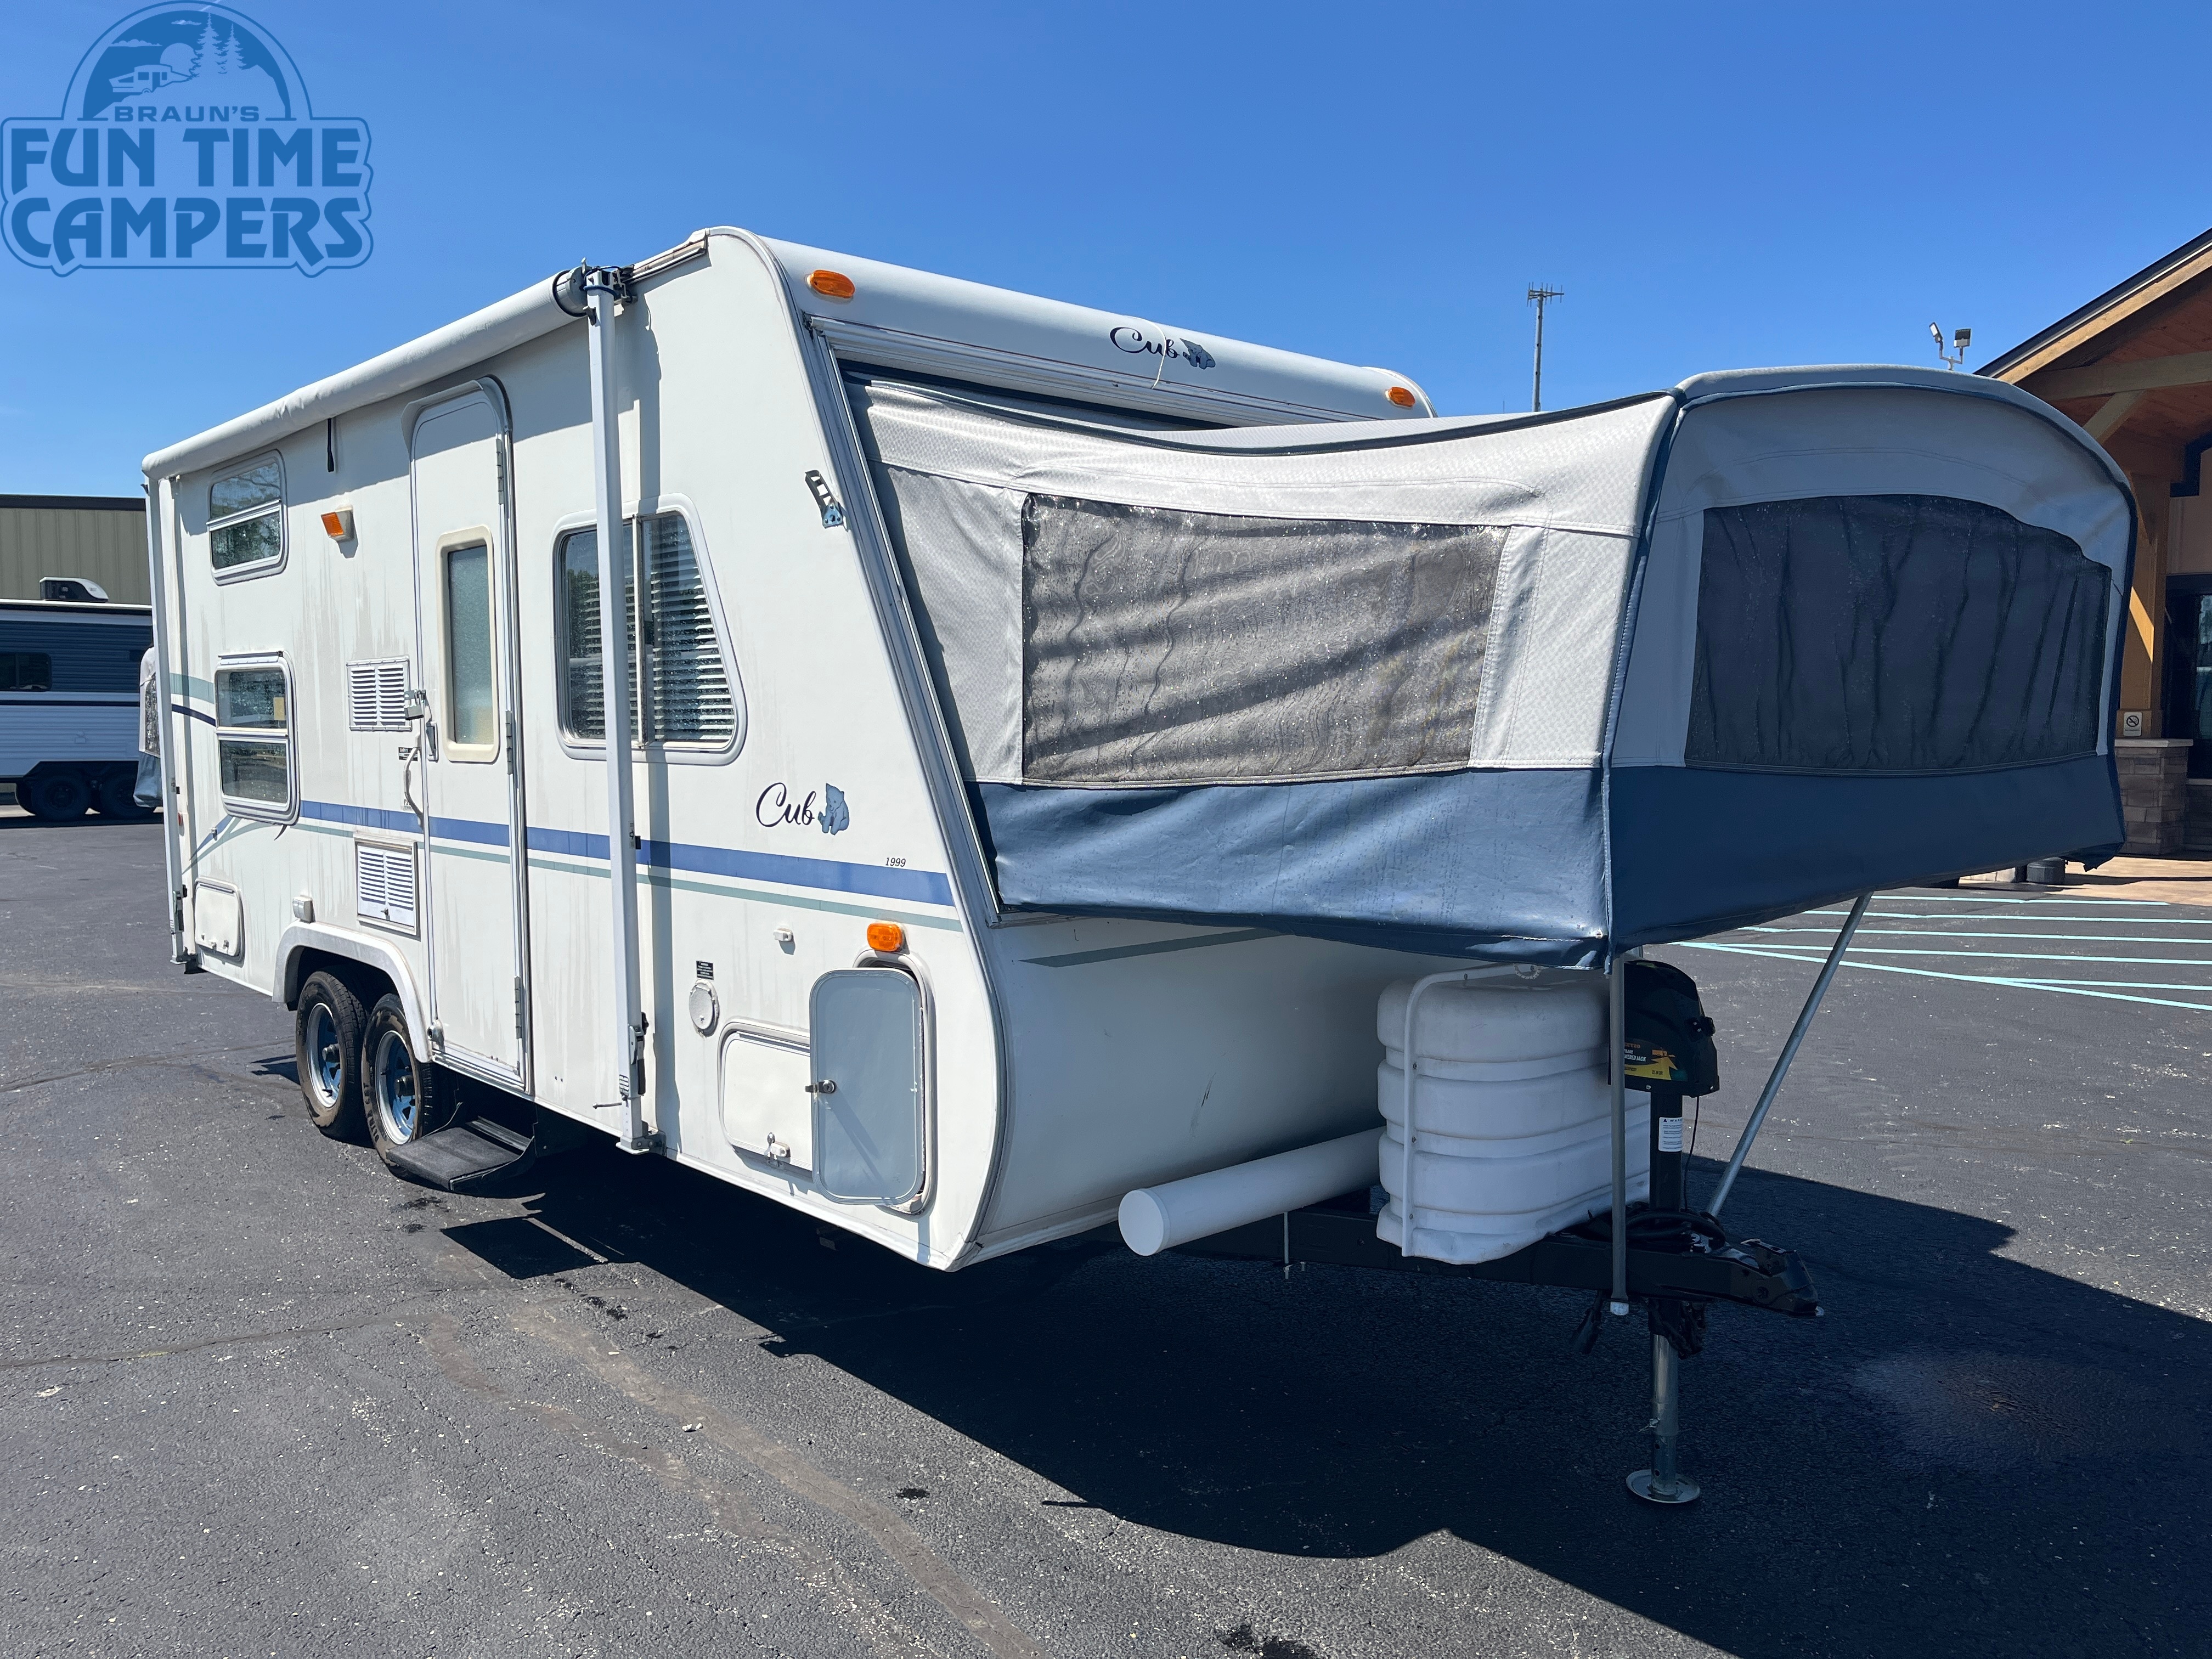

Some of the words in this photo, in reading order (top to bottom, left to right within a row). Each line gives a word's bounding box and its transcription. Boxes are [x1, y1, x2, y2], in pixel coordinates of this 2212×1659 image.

[1110, 327, 1180, 358] Cub
[756, 782, 816, 827] Cub
[885, 857, 906, 867] 1999
